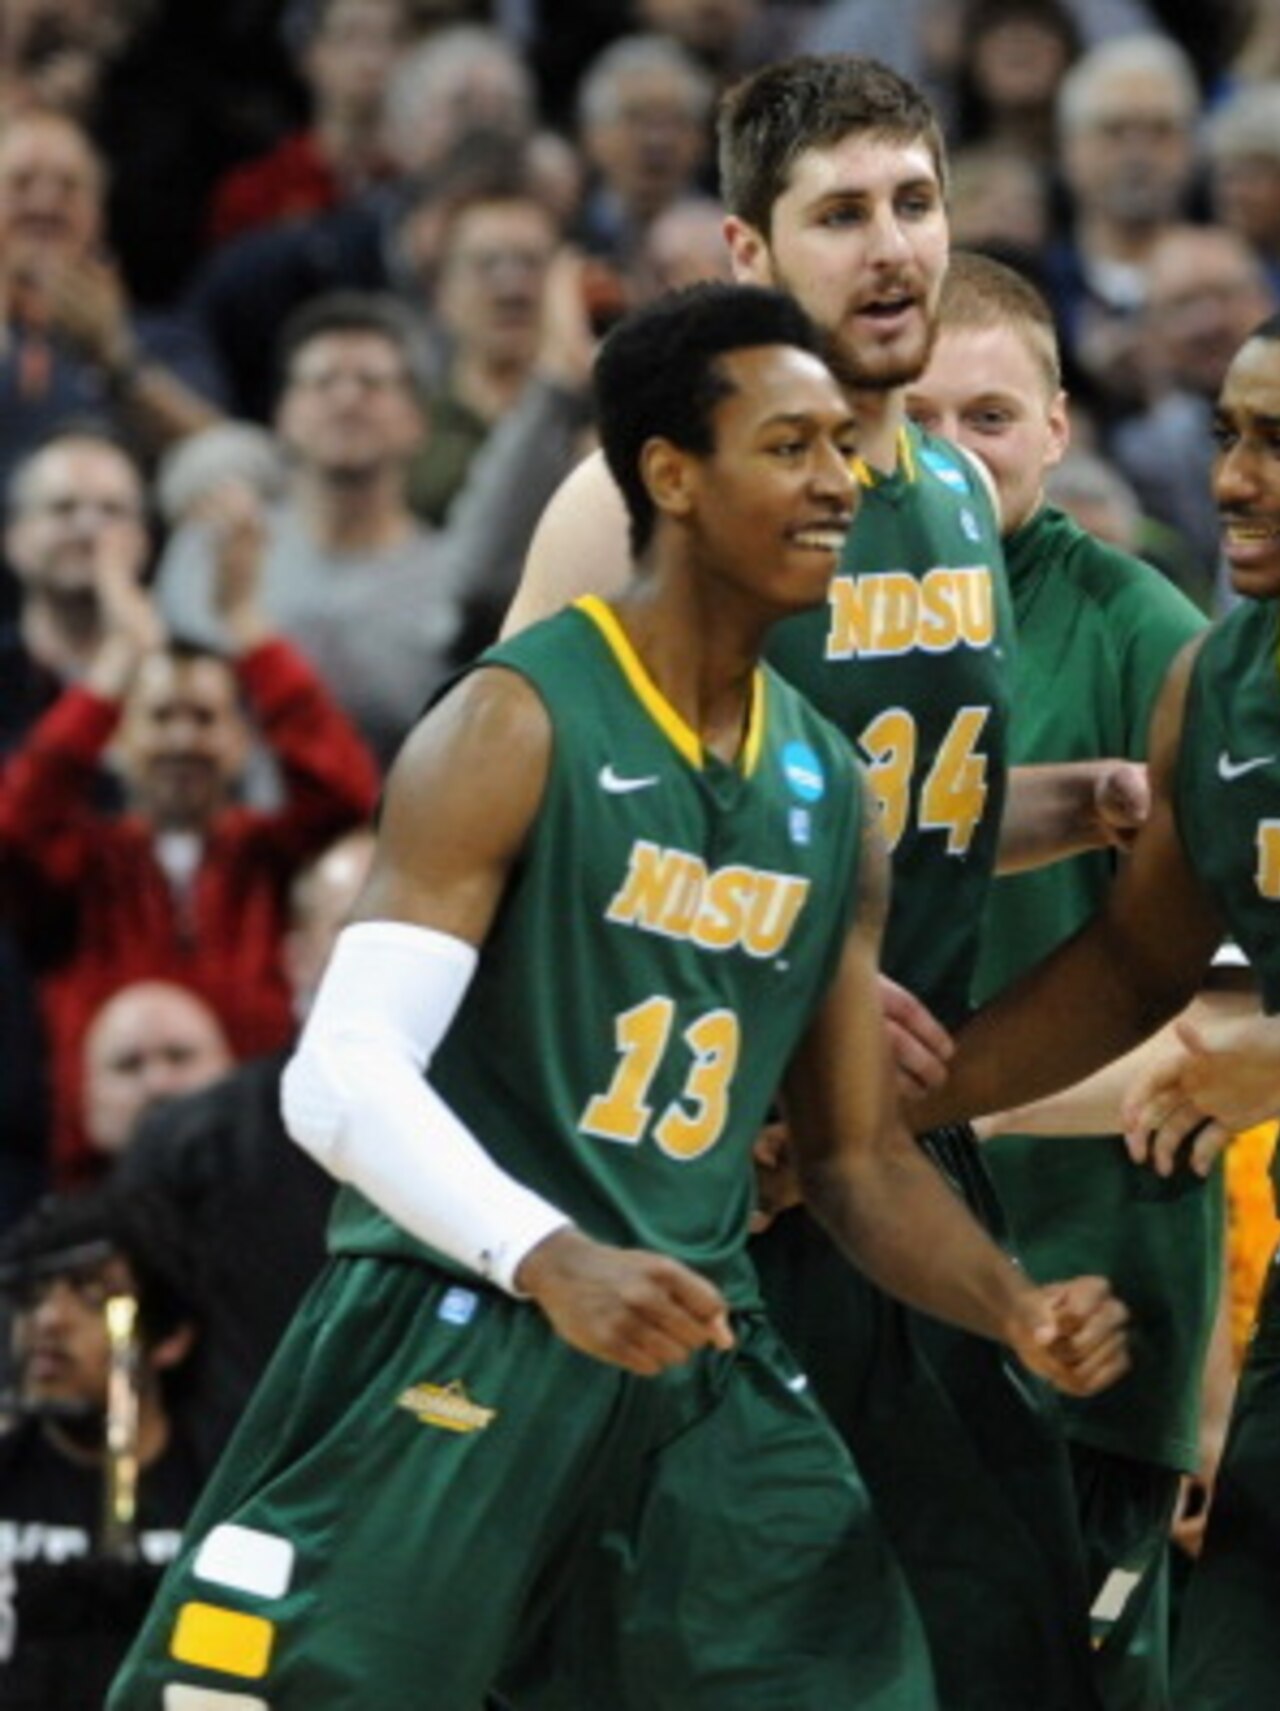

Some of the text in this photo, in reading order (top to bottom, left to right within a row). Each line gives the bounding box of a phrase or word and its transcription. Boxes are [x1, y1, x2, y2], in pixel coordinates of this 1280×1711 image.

[825, 566, 995, 660] NDSU
[858, 705, 991, 855] 34
[604, 839, 810, 958] NDSU
[578, 994, 739, 1159] 13
